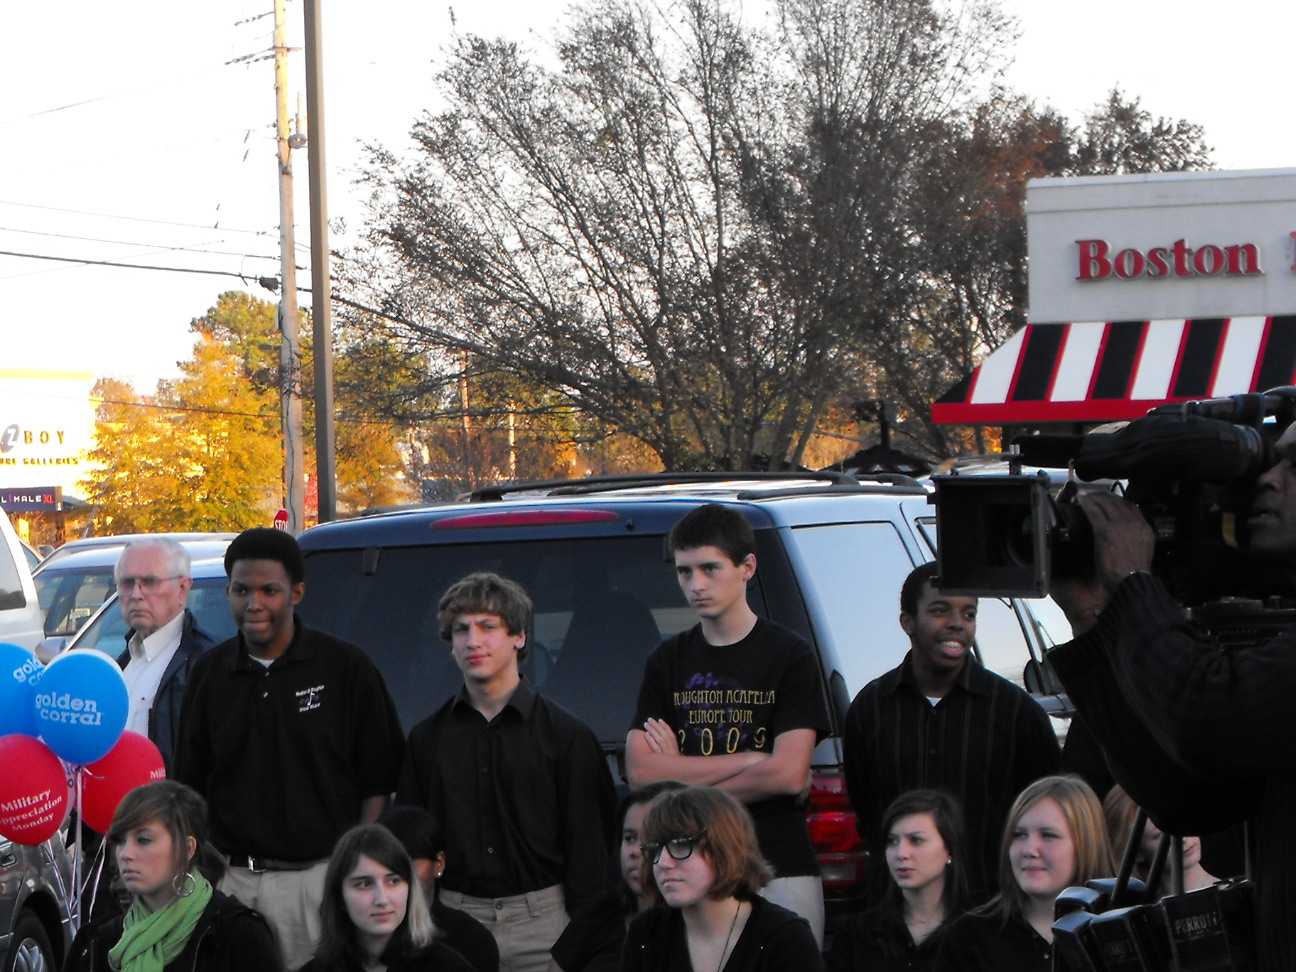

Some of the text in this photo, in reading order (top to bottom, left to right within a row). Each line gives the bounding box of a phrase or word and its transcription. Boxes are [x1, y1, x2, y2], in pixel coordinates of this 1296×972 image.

[1075, 238, 1262, 280] Boston
[23, 457, 79, 466] GALLERIES
[13, 495, 42, 503] MALE
[43, 494, 55, 504] XL
[13, 656, 45, 682] gold
[35, 692, 97, 712] golden
[40, 709, 102, 725] corral
[689, 709, 753, 724] EUROPE TOUR
[0, 789, 51, 813] Military
[12, 813, 54, 832] Monday
